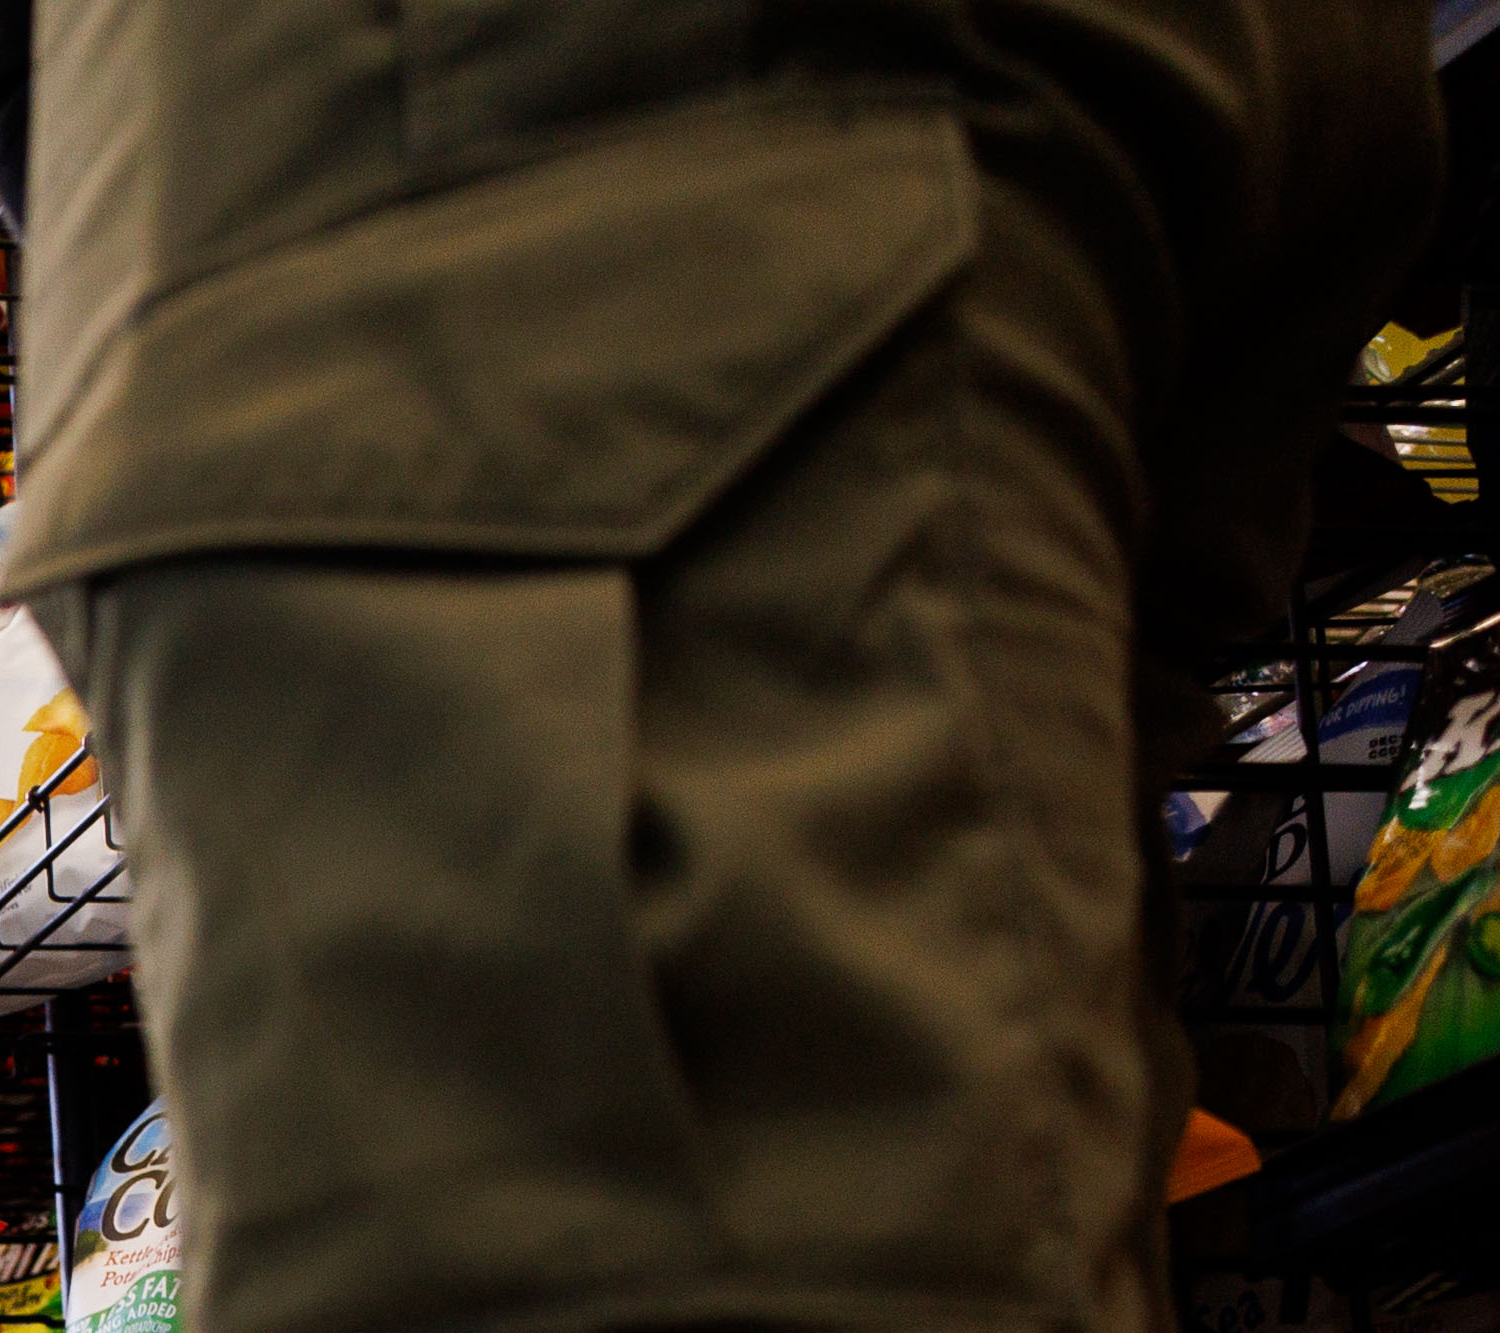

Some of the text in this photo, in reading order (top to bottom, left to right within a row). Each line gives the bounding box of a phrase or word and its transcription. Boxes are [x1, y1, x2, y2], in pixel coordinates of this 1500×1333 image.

[1345, 683, 1408, 719] DIPPING!
[101, 1169, 182, 1242] CO
[141, 1275, 182, 1301] FAT
[126, 1302, 177, 1322] ADDED
